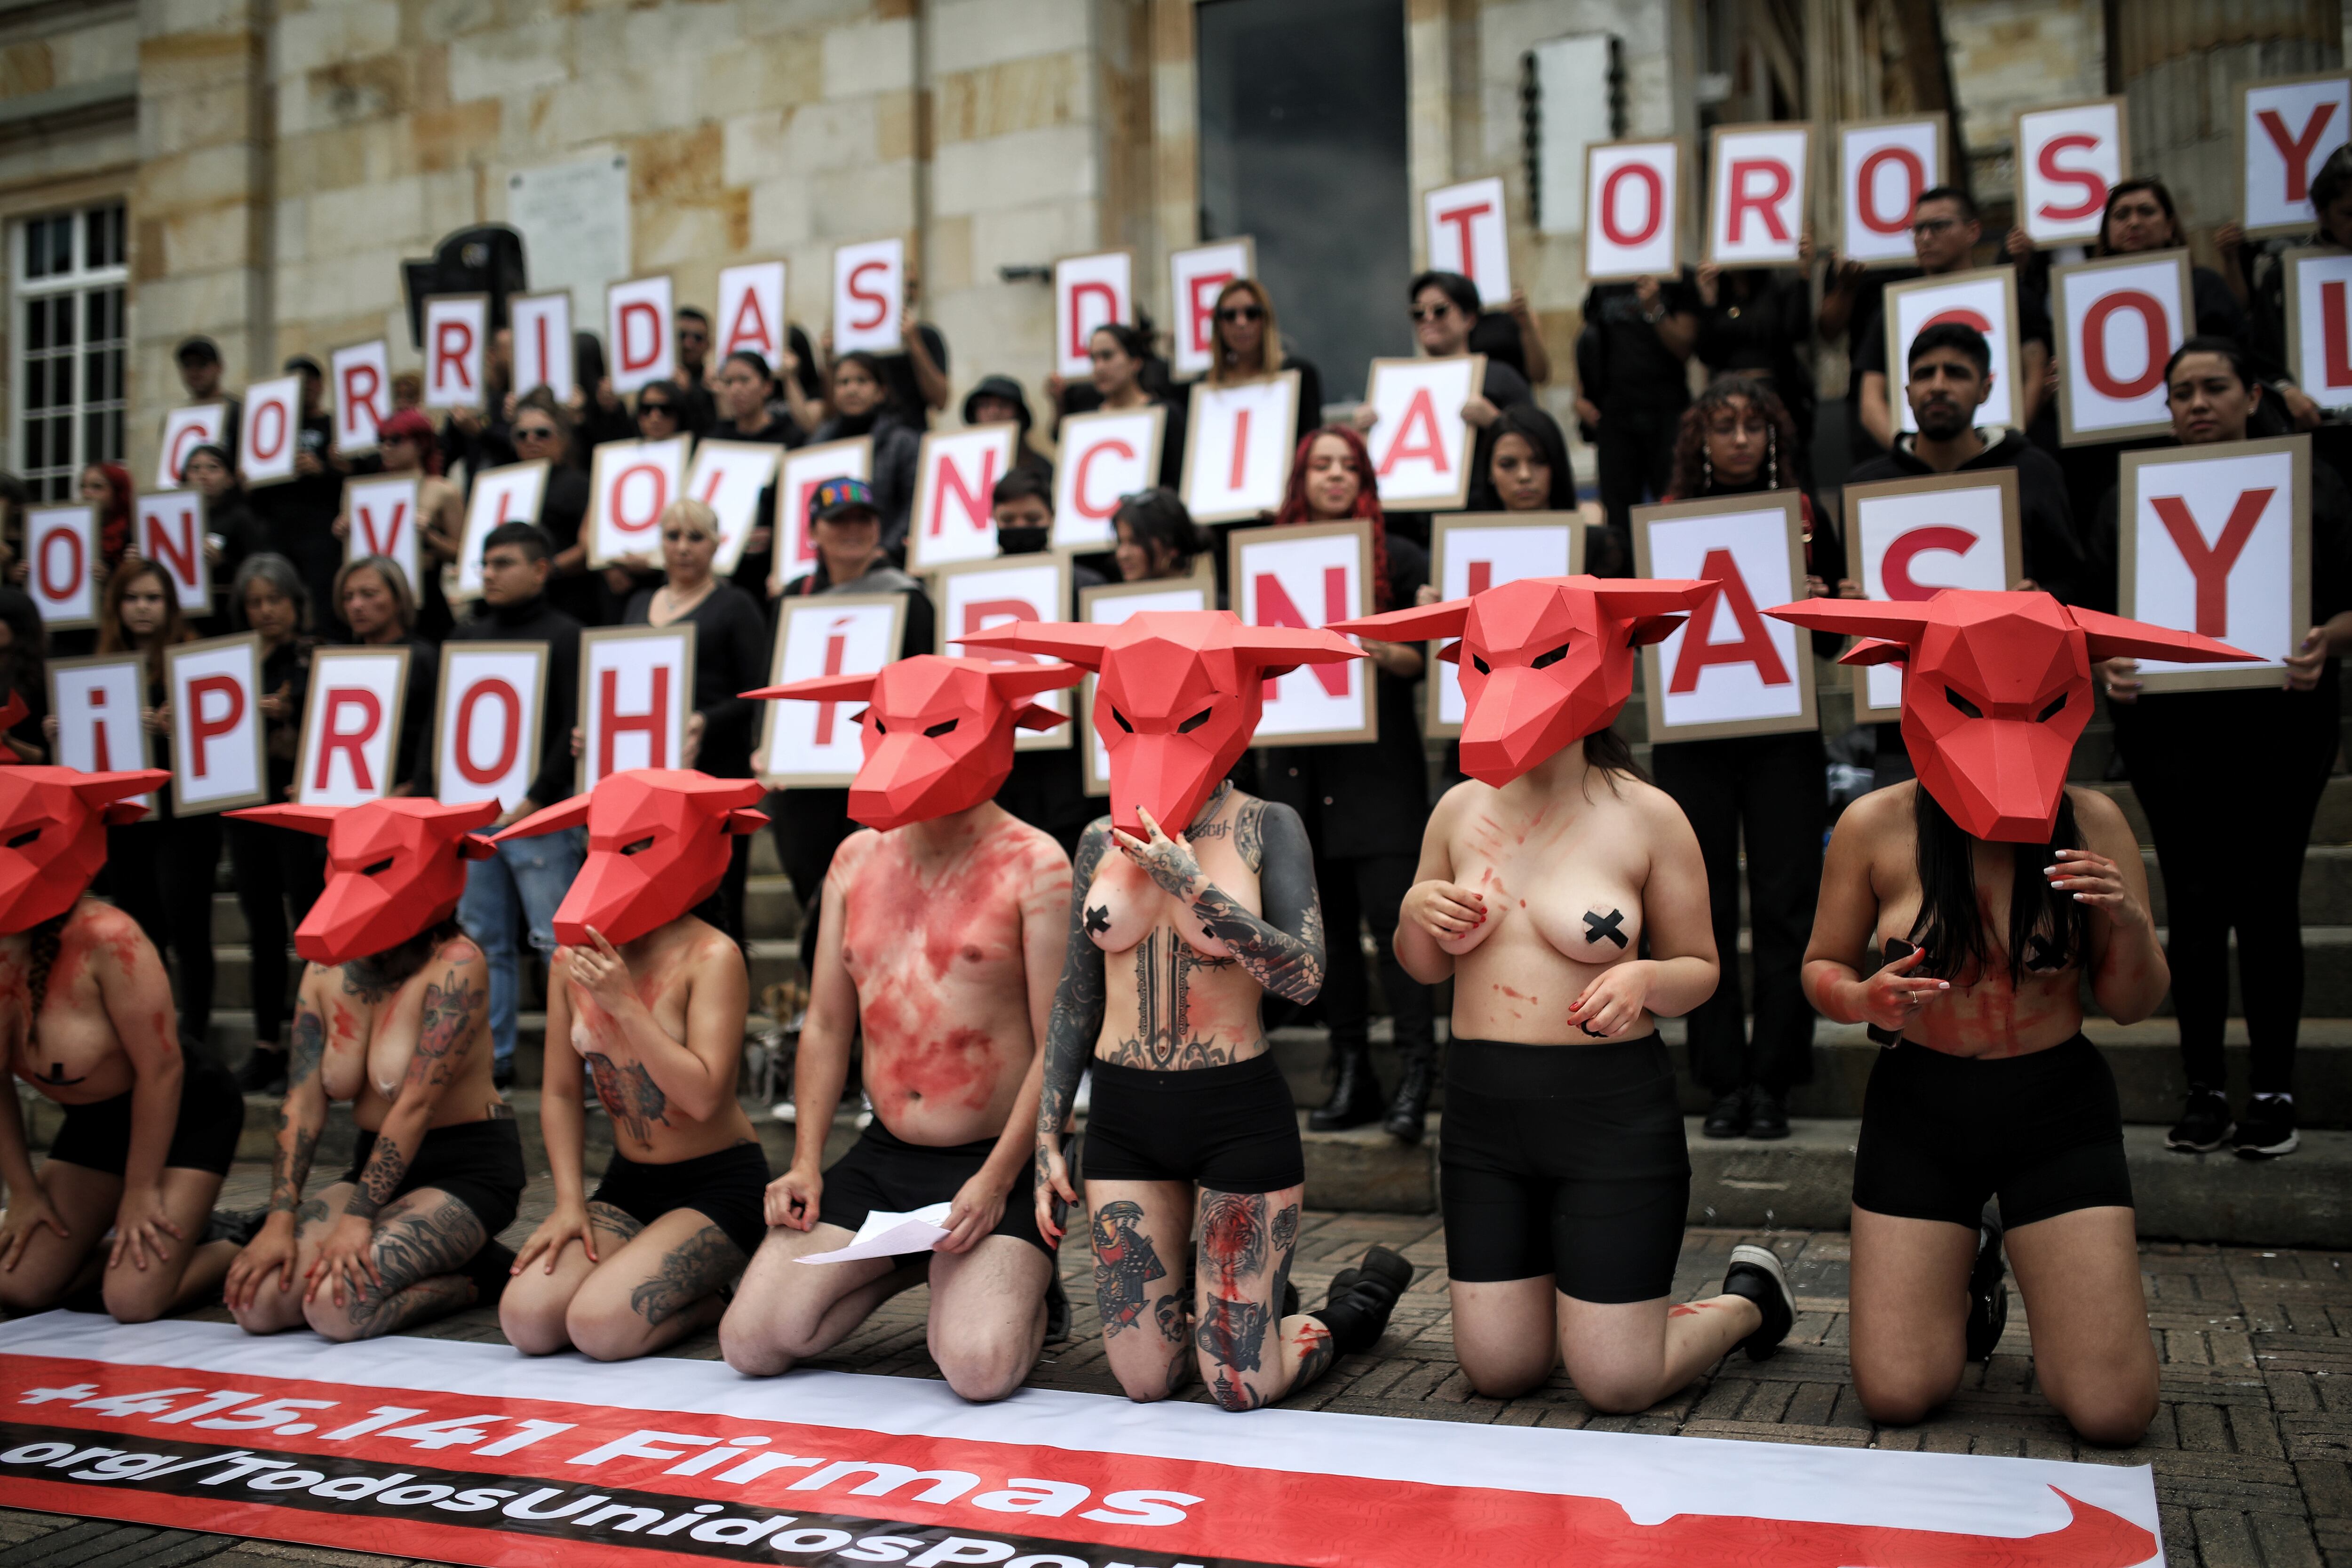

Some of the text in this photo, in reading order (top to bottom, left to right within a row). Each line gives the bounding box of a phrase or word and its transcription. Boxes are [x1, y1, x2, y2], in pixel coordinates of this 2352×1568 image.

[1858, 148, 1926, 233] O
[2038, 135, 2107, 220] S
[2258, 103, 2337, 201] Y
[1440, 204, 1490, 279] T
[1602, 163, 1662, 246] O
[1728, 160, 1792, 243] R
[620, 302, 661, 372] D
[726, 287, 771, 355] A
[849, 262, 888, 331] S
[1071, 283, 1118, 358] D
[437, 322, 472, 387] R
[537, 318, 548, 386] I
[2082, 291, 2170, 398] O
[252, 401, 286, 460] O
[345, 365, 390, 434] R
[1376, 389, 1449, 476] A
[170, 425, 206, 480] C
[1074, 440, 1135, 519] C
[1230, 410, 1249, 489] I
[360, 503, 405, 557] V
[611, 464, 667, 533] O
[931, 449, 995, 536] N
[40, 528, 83, 600] O
[147, 513, 196, 585] N
[2151, 488, 2276, 637] Y
[1255, 567, 1349, 700] N
[1669, 549, 1791, 693] A
[190, 676, 245, 776] P
[315, 689, 382, 790] R
[455, 679, 521, 784] O
[598, 667, 669, 779] H
[17, 1383, 1206, 1527] +415.141 Firmas
[0, 1441, 1205, 1568] org/TodosUnidosP
